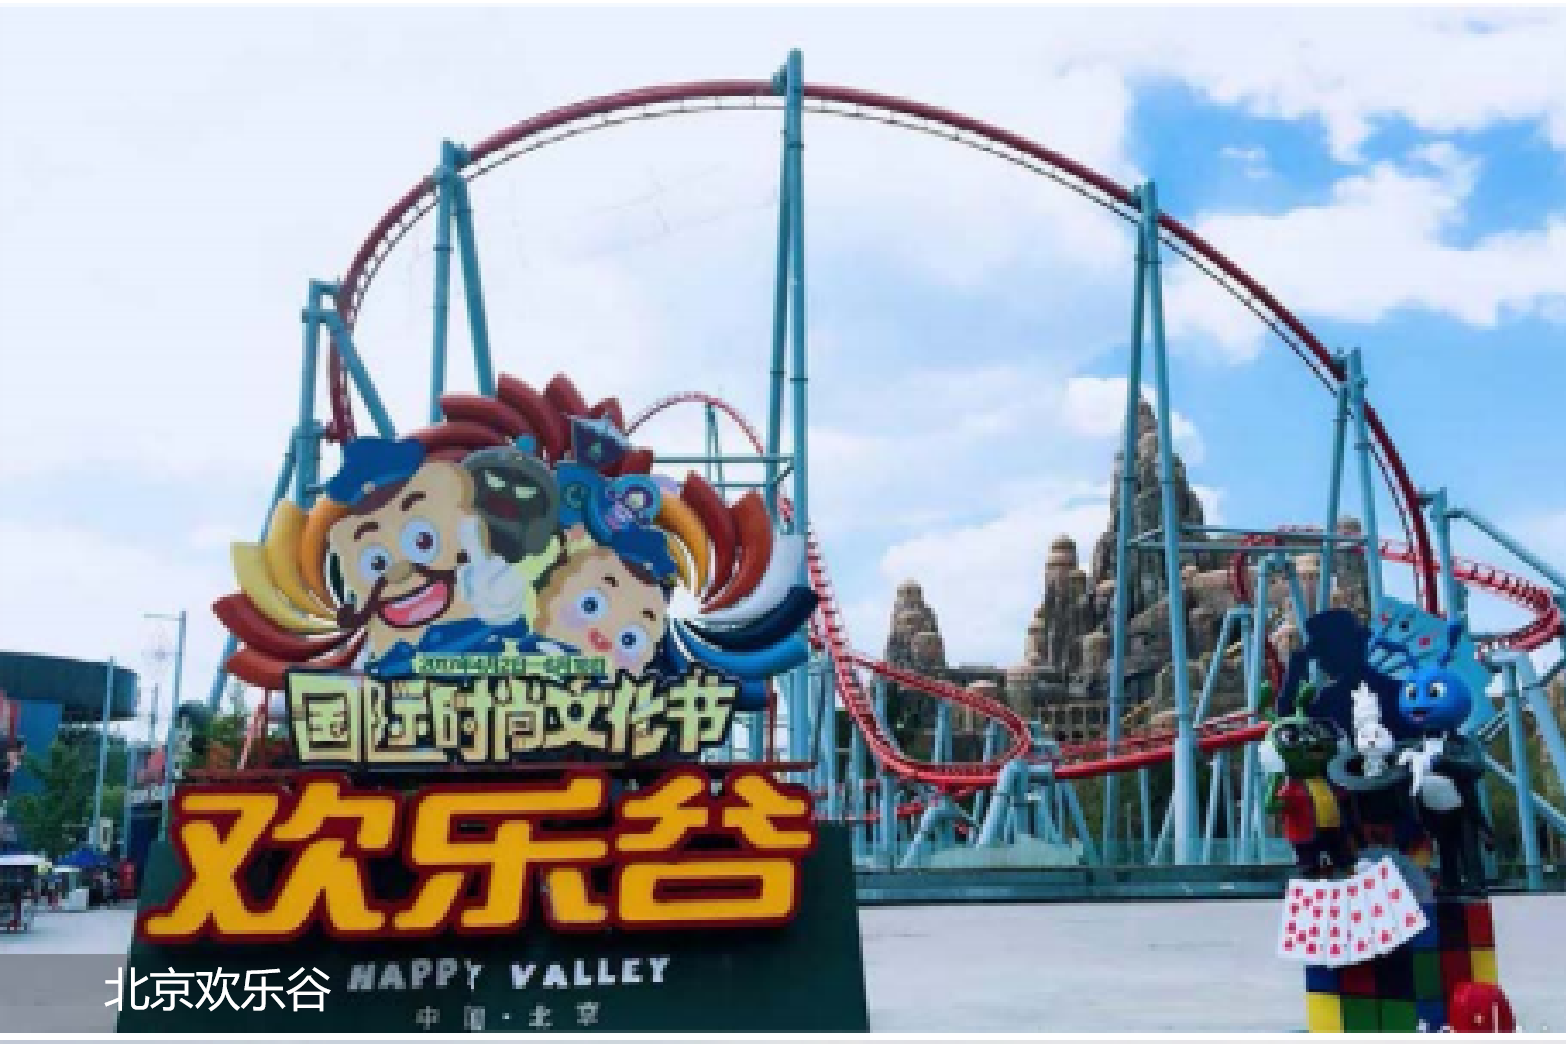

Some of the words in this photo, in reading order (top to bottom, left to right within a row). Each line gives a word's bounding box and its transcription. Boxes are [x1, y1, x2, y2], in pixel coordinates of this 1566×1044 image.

[287, 665, 740, 764] 国际时尚文化节
[144, 768, 815, 940] 欢乐谷
[347, 958, 482, 991] HAPPY
[511, 957, 670, 990] VALLEY
